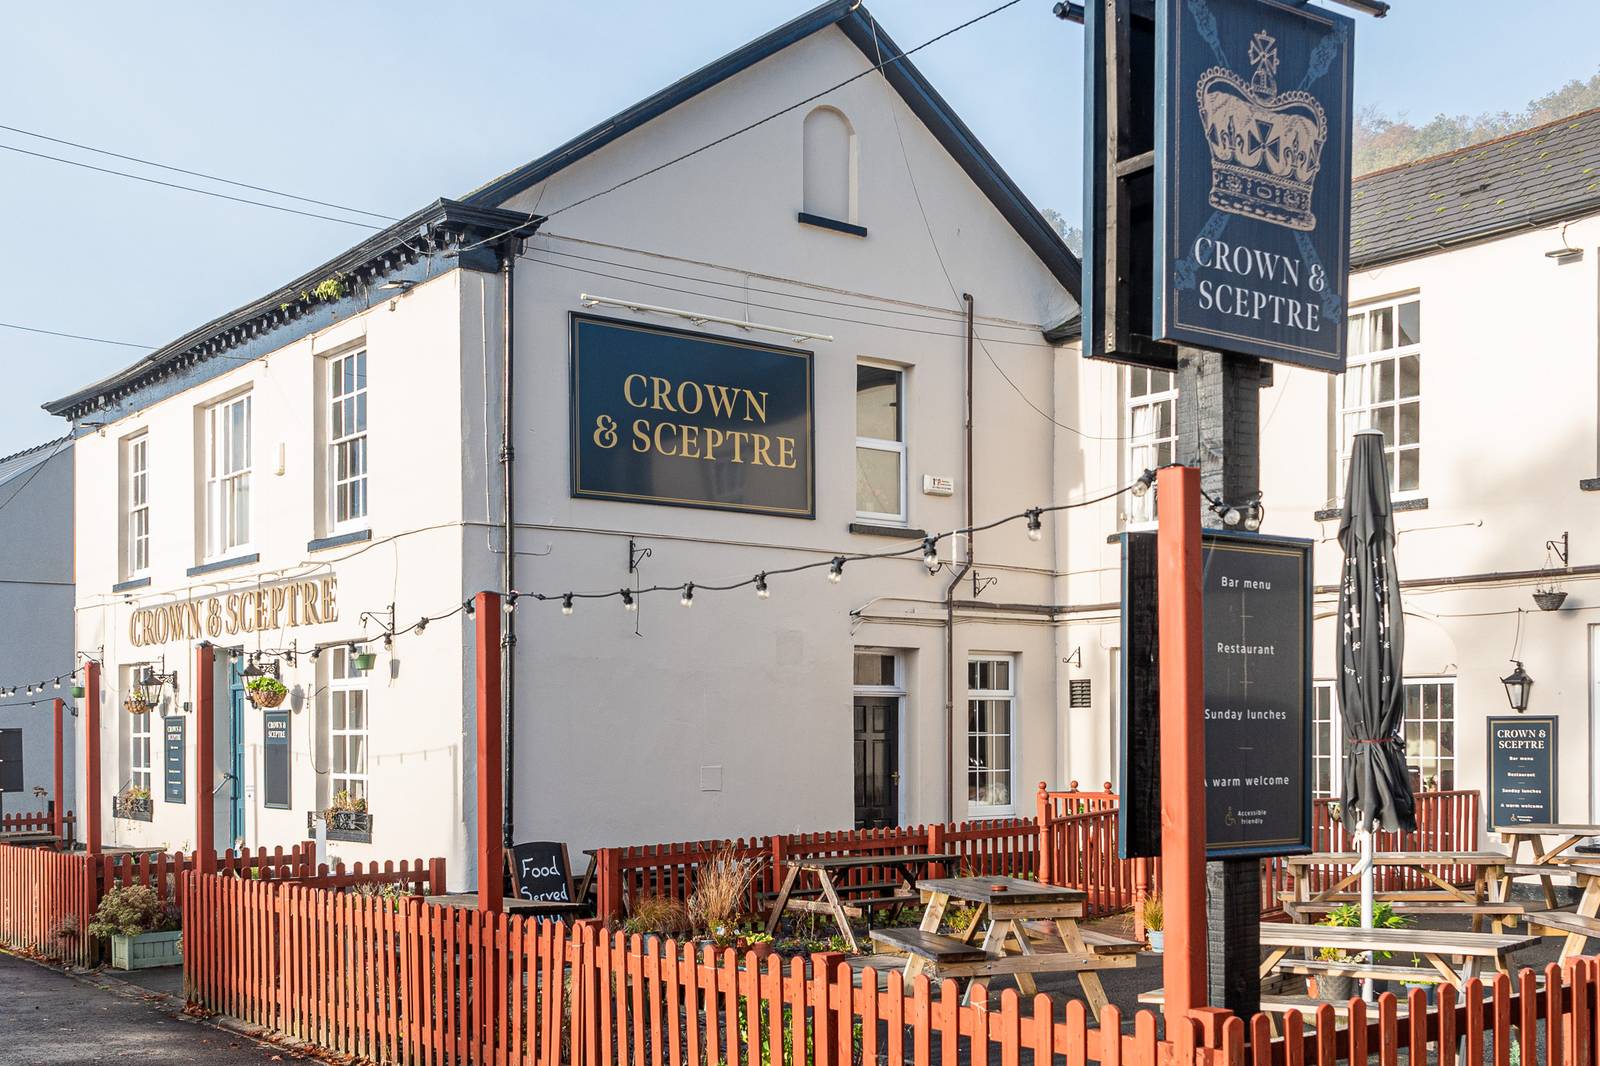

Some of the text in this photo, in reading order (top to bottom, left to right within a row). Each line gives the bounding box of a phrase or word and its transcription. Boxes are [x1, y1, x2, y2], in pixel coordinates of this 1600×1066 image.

[1194, 236, 1325, 292] CROWN &
[1198, 279, 1320, 332] SCEPTRE
[623, 373, 769, 423] CROWN
[593, 414, 797, 469] & SCEPTRE
[1221, 576, 1271, 590] Bar menu
[129, 576, 339, 648] CROWN & SCEPTRE
[1217, 642, 1275, 655] Restaurant
[1204, 708, 1287, 720] Sunday lunches
[1497, 729, 1546, 738] CROWN &
[1498, 740, 1545, 749] SCEPTRE
[1212, 777, 1241, 787] warm
[1245, 775, 1290, 786] welcome
[1237, 809, 1267, 817] Accessible
[522, 855, 560, 879] Food
[520, 883, 568, 901] Served
